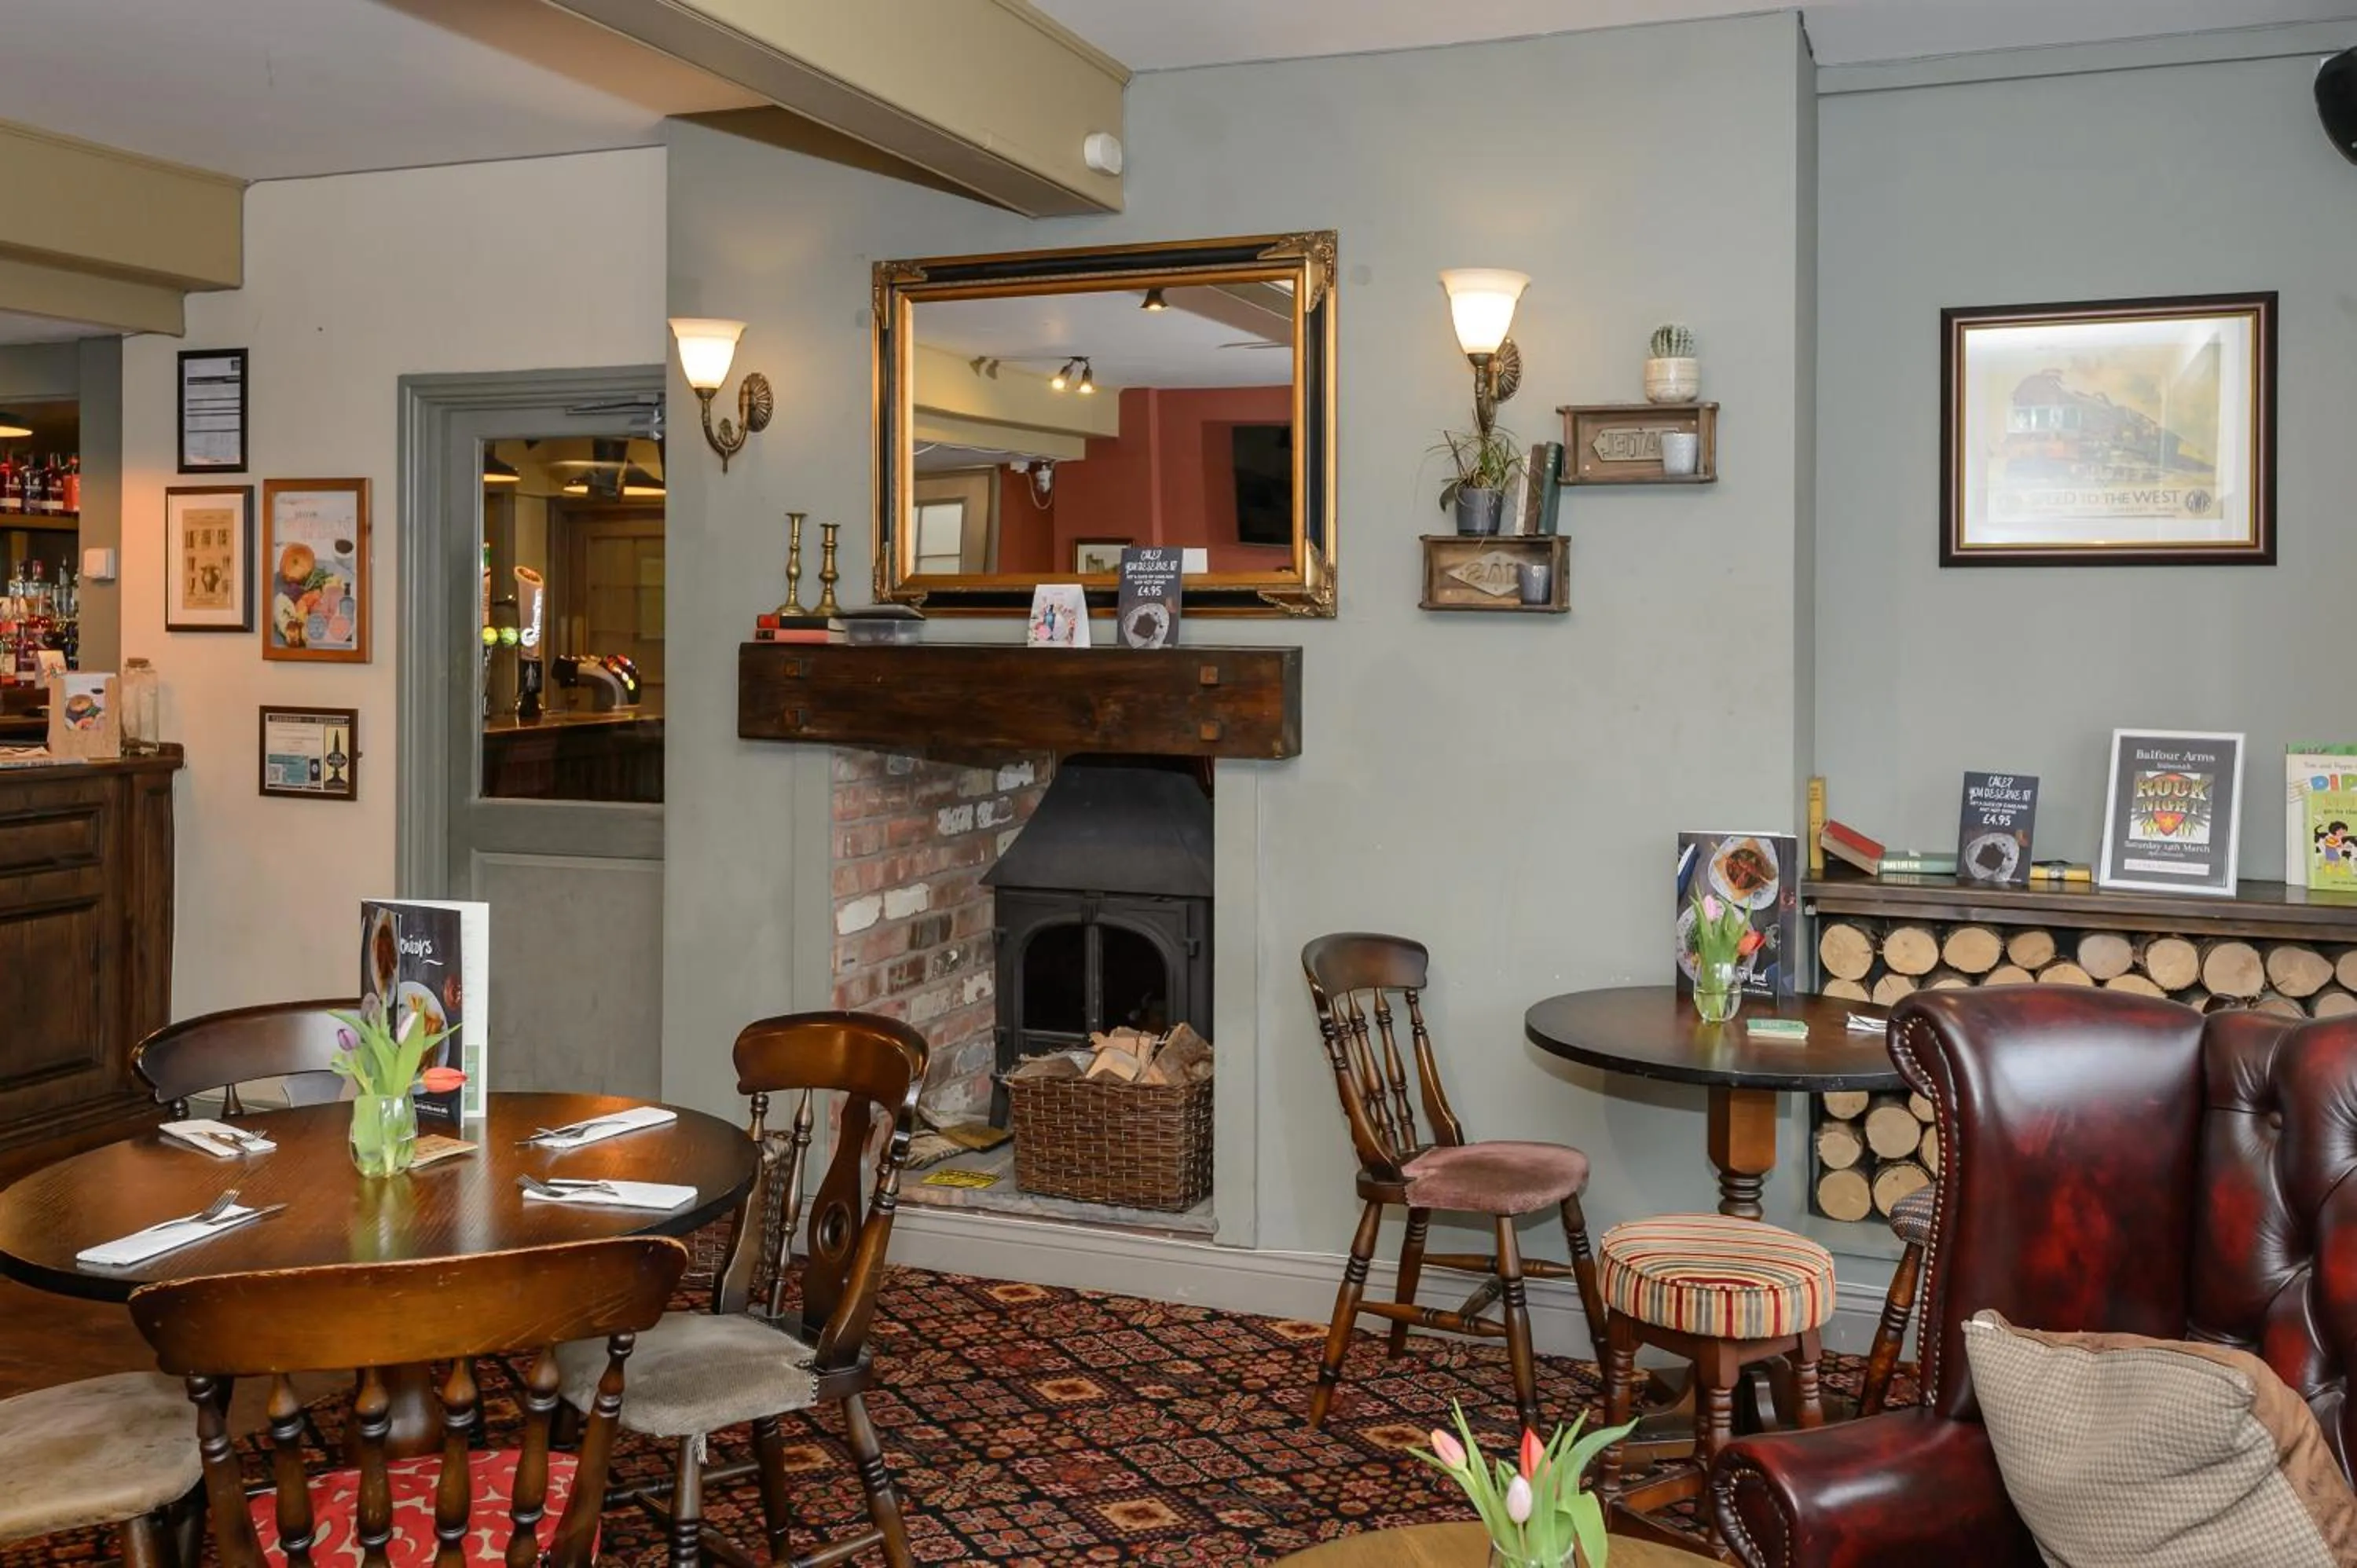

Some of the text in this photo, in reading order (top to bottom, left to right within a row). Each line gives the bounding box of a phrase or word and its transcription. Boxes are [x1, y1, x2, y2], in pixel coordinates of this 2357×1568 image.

[2104, 490, 2130, 504] THE
[2132, 489, 2181, 504] WEST
[2135, 749, 2216, 762] Balfour Arms
[2136, 778, 2209, 801] ROCK
[2141, 800, 2199, 815] NIGHT
[1982, 813, 2011, 826] £4.95
[2183, 844, 2210, 854] March
